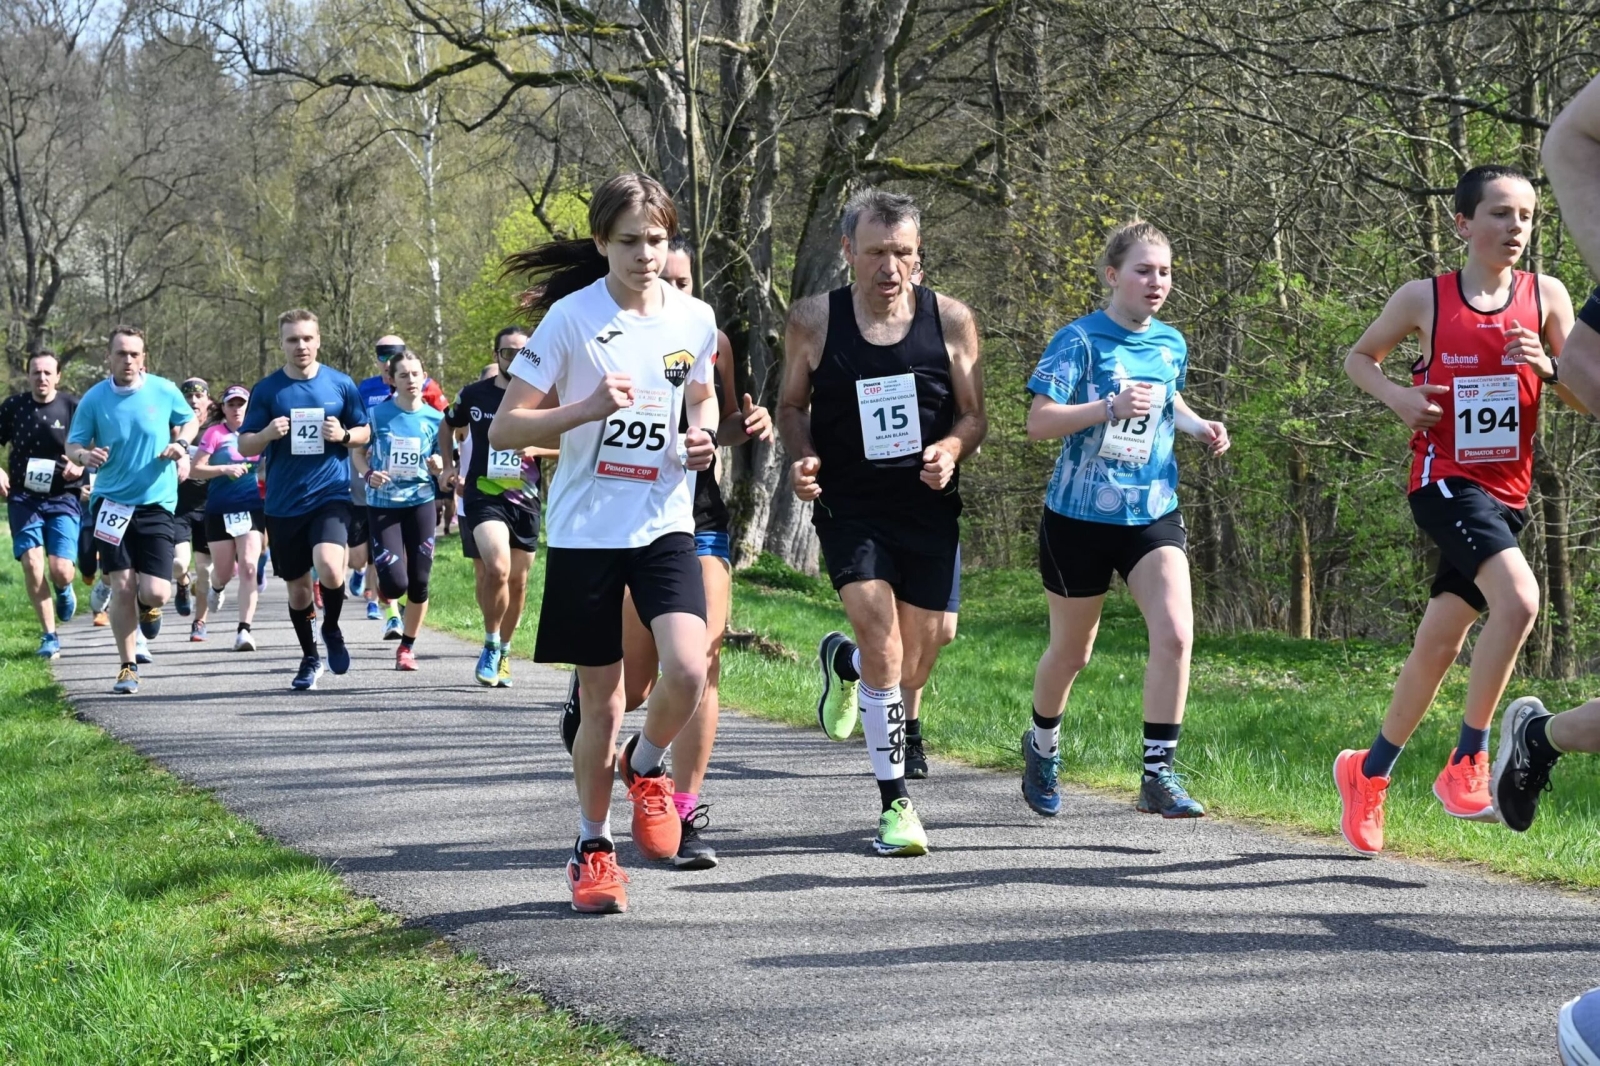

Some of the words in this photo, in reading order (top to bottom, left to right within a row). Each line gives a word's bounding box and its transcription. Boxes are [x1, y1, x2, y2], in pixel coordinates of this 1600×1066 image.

[864, 386, 882, 395] CUP
[1457, 389, 1479, 398] CUP
[872, 404, 909, 432] 15
[1457, 406, 1519, 434] 194
[297, 424, 319, 439] 42
[602, 418, 666, 452] 295
[391, 451, 419, 465] 159
[490, 451, 520, 467] 126
[1464, 449, 1494, 457] PRIMATOR
[604, 463, 636, 475] PRIMATOR
[636, 468, 652, 476] CUP
[27, 470, 52, 484] 142
[99, 510, 129, 530] 187
[225, 512, 250, 525] 134
